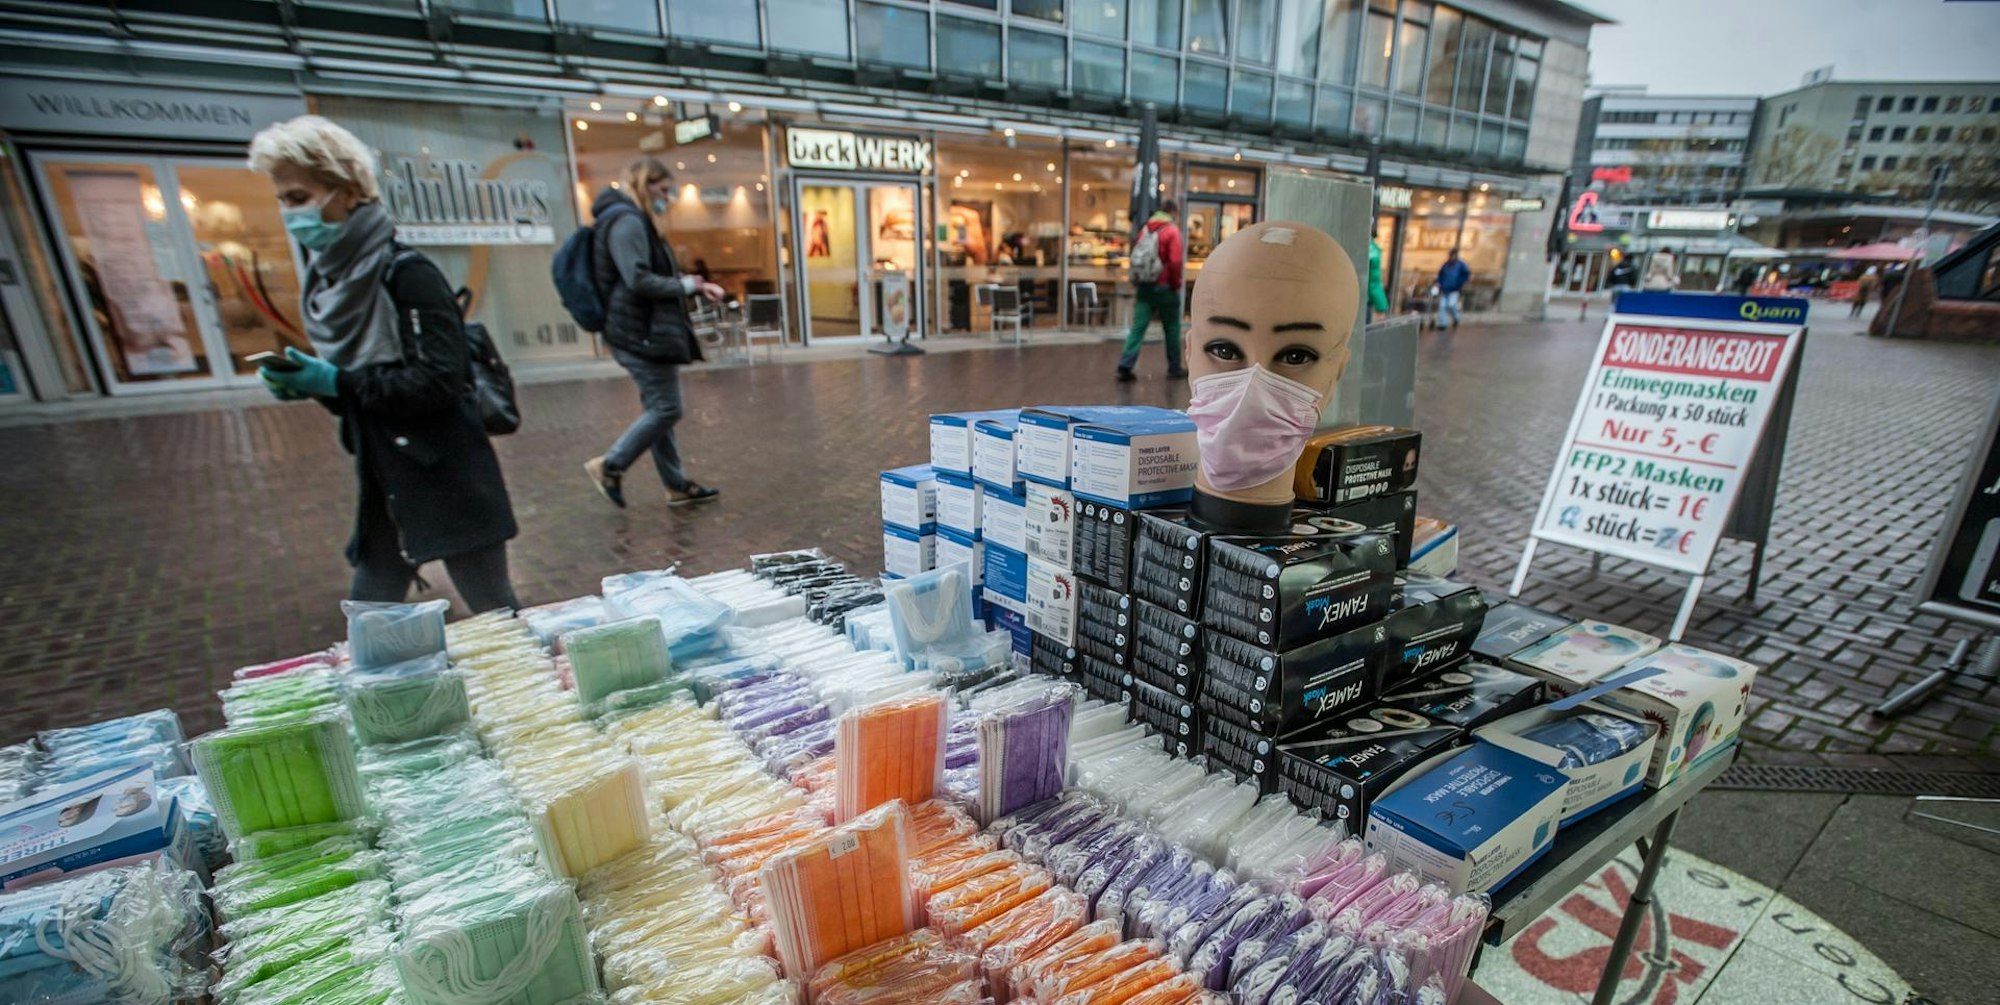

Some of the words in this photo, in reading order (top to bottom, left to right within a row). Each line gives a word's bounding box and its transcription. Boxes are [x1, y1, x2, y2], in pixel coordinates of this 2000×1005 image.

[27, 93, 251, 126] WILLKOMMEN
[385, 161, 549, 241] chillings
[1740, 301, 1801, 321] Quam
[1609, 329, 1779, 375] SONDERANGEBOT
[1601, 369, 1757, 404] Einwegmasken
[1595, 393, 1603, 408] 1
[1606, 396, 1667, 423] Packung
[1670, 407, 1679, 419] x
[1682, 404, 1705, 422] 50
[1706, 406, 1747, 428] stück
[1600, 417, 1652, 445] Nur
[1138, 453, 1180, 466] DISPOSABLE
[1138, 464, 1180, 477] PROTECTIVE
[1345, 461, 1380, 475] DISPOSABLE
[1570, 450, 1627, 477] FFP2
[1631, 459, 1725, 494] Masken
[1344, 471, 1378, 485] PROTECTIVE
[1378, 467, 1393, 479] MASK
[1569, 476, 1591, 500] 1x
[1677, 494, 1710, 521] 1€
[1305, 595, 1331, 616] Mask
[1318, 593, 1369, 631] FAMEX
[1411, 641, 1459, 674] FAMEX
[1303, 686, 1327, 708] Mask
[1318, 680, 1363, 719] FAMEX
[1348, 743, 1387, 768] FAMEX
[1443, 765, 1488, 792] PROTECTIVE
[1456, 770, 1502, 798] DISPOSABLE
[1423, 786, 1450, 804] MASK
[1470, 847, 1508, 878] DISPOSABLE
